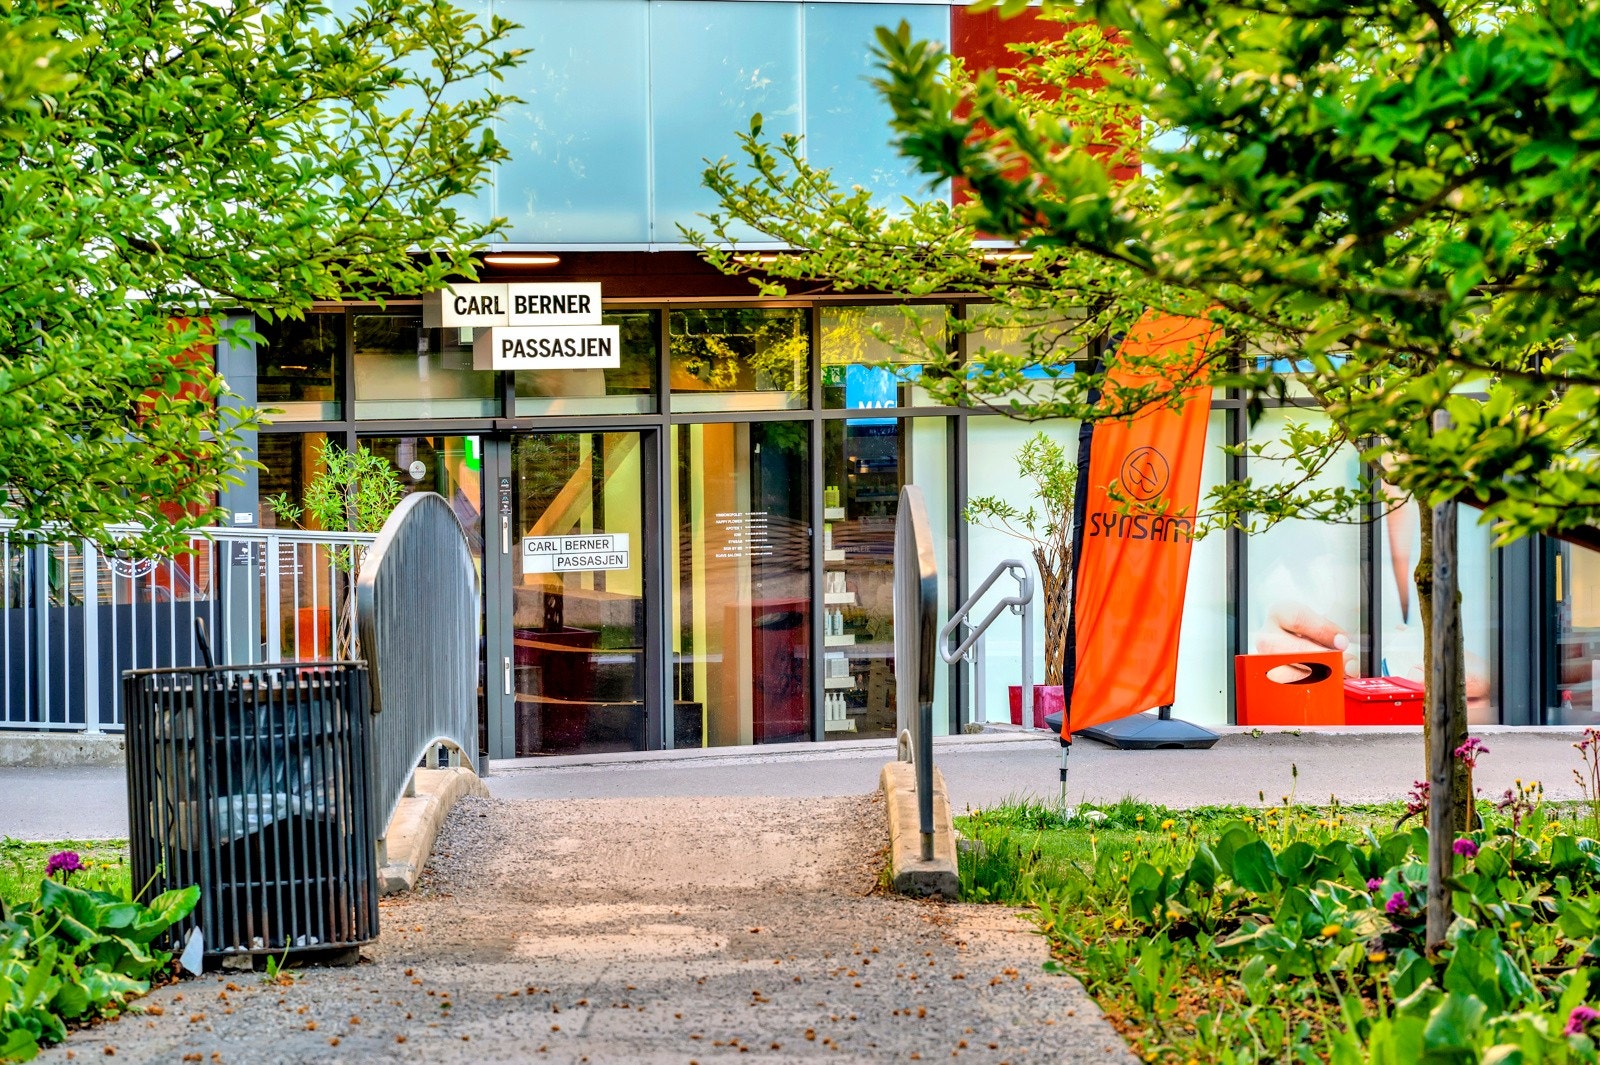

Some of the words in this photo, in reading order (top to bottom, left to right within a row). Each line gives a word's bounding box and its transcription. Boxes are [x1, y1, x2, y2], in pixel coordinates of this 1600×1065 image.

[454, 296, 506, 315] CARL
[514, 295, 591, 314] BERNER
[502, 338, 611, 359] PASSASJEN
[528, 542, 558, 552] CARL
[565, 540, 609, 551] BERNER
[557, 555, 624, 567] PASSASJEN
